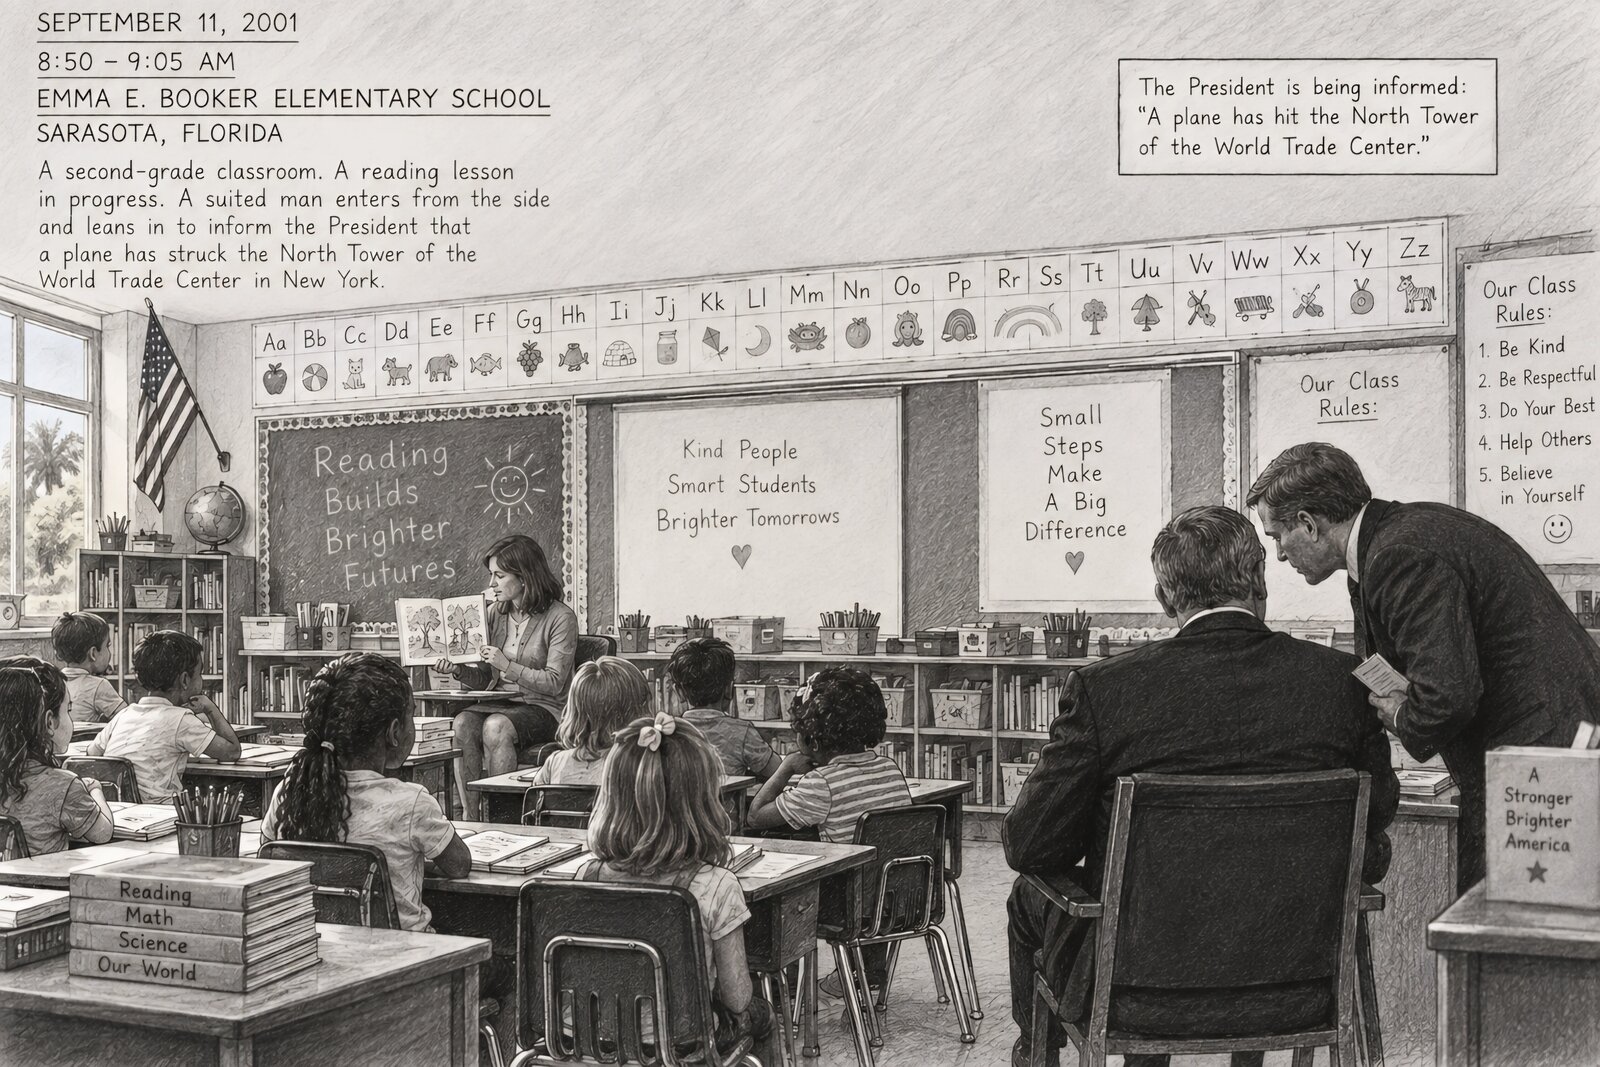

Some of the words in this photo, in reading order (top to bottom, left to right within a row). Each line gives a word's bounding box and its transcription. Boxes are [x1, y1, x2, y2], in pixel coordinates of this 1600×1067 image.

[262, 332, 287, 352] Aa
[304, 328, 327, 349] Bb
[344, 325, 367, 345] Cc
[385, 320, 409, 342] Dd
[430, 317, 453, 337] Ee
[474, 311, 496, 334] Ff
[516, 309, 542, 335] Gg
[562, 304, 586, 325] Hh
[654, 295, 675, 323] Jj
[701, 291, 725, 313] Kk
[790, 284, 824, 305] Mm
[844, 279, 870, 301] Nn
[894, 275, 921, 296] Oo
[948, 271, 972, 298] Pp
[998, 267, 1021, 289] Rr
[1040, 265, 1063, 287] Ss
[1080, 262, 1104, 283] Tt
[1131, 257, 1160, 280] Uu
[1189, 252, 1214, 274] Vv
[1231, 248, 1269, 271] Ww
[1293, 244, 1321, 267] Xx
[1346, 240, 1373, 268] Yy
[1399, 236, 1430, 259] Zz
[1483, 280, 1518, 299] Our
[1528, 274, 1576, 296] Class
[1496, 302, 1552, 323] Rules:
[1478, 342, 1490, 359] 1.
[1499, 340, 1519, 358] Be
[1529, 335, 1565, 355] Kind
[1300, 374, 1335, 394] Our
[1349, 370, 1399, 391] Class
[1478, 373, 1492, 389] 2.
[1499, 370, 1517, 388] Be
[1523, 364, 1596, 391] Respectful
[1040, 403, 1102, 428] Small
[1320, 396, 1378, 418] Rules:
[1479, 403, 1492, 420] 3.
[1500, 401, 1518, 419] Do
[1524, 399, 1556, 417] Your
[1564, 396, 1596, 415] Best
[683, 439, 723, 459] Kind
[740, 438, 798, 467] People
[1043, 436, 1103, 461] Steps
[1478, 434, 1493, 451] 4.
[1500, 431, 1533, 456] Help
[1541, 429, 1592, 448] Others
[314, 439, 448, 478] Reading
[667, 473, 725, 495] Smart
[738, 473, 816, 494] Students
[1048, 462, 1102, 485] Make
[1479, 466, 1493, 483] 5.
[1501, 464, 1553, 482] Believe
[325, 478, 419, 516] Builds
[1044, 492, 1059, 512] A
[1075, 491, 1106, 518] Big
[1501, 488, 1514, 505] in
[1522, 483, 1586, 504] Yourself
[657, 508, 738, 539] Brighter
[746, 507, 840, 527] Tomorrows
[1025, 519, 1127, 542] Difference
[326, 517, 451, 558] Brighter
[343, 559, 456, 592] Futures
[1528, 766, 1540, 783] A
[1504, 786, 1573, 810] Stronger
[1506, 809, 1572, 833] Brighter
[1505, 832, 1571, 853] America
[120, 880, 192, 907] Reading
[125, 906, 173, 927] Math
[118, 931, 188, 955] Science
[97, 955, 132, 974] Our
[141, 957, 197, 982] World
